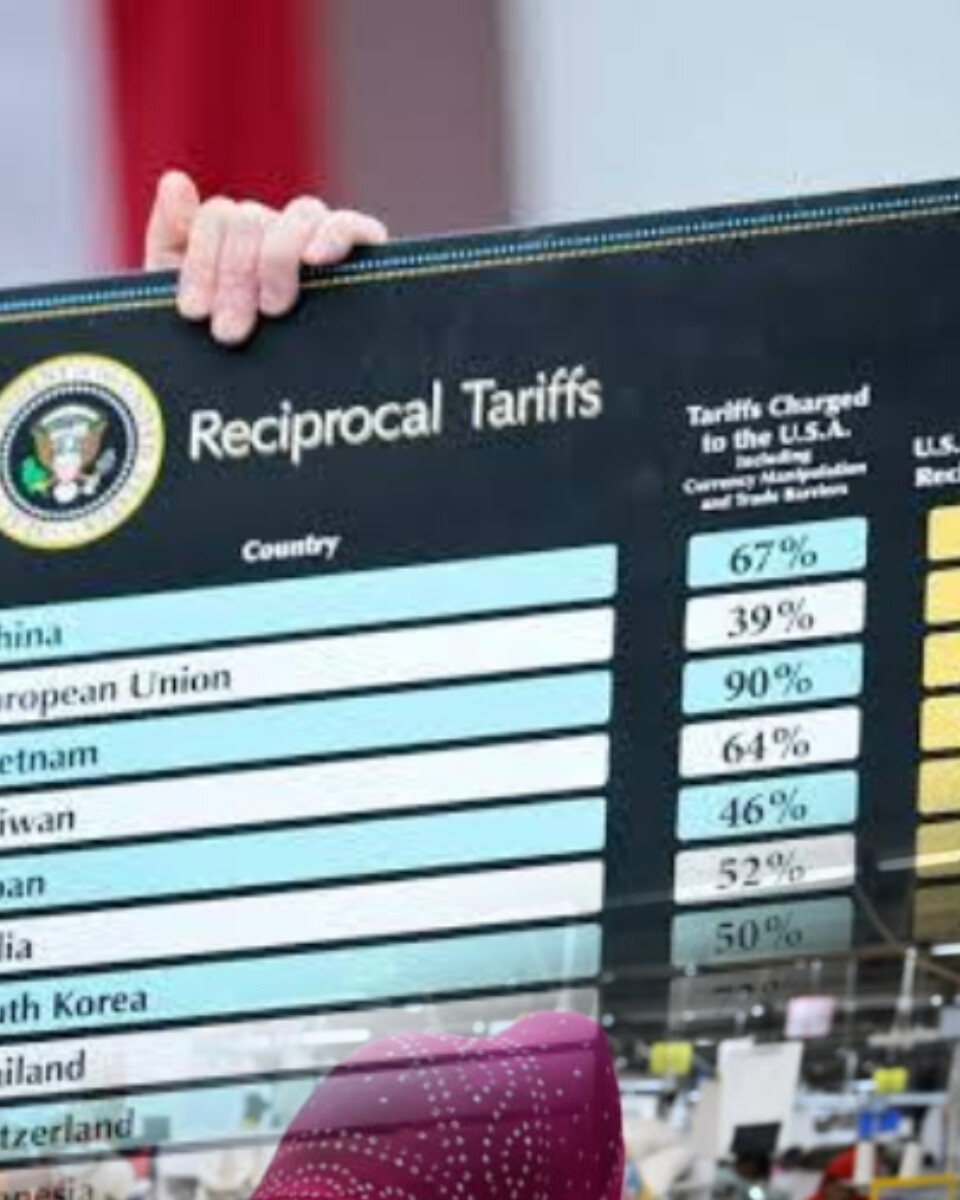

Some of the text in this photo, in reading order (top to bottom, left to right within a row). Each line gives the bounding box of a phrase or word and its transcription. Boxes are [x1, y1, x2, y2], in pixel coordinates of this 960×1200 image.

[188, 376, 443, 467] Reciprocal
[459, 363, 603, 431] Tariffs
[686, 384, 871, 427] Tariffs Charged
[701, 417, 852, 453] to the U.S.A.
[682, 461, 868, 495] Currency Manipulation
[701, 483, 849, 511] and Trade Barriers
[242, 535, 340, 563] Country
[730, 534, 818, 575] 67%
[727, 597, 815, 638] 39%
[130, 666, 232, 699] Union
[724, 662, 813, 701] 90%
[723, 724, 810, 764] 64%
[719, 787, 808, 828] 46%
[715, 851, 806, 890] 52%
[713, 914, 803, 954] 50%
[52, 989, 148, 1017] Korea
